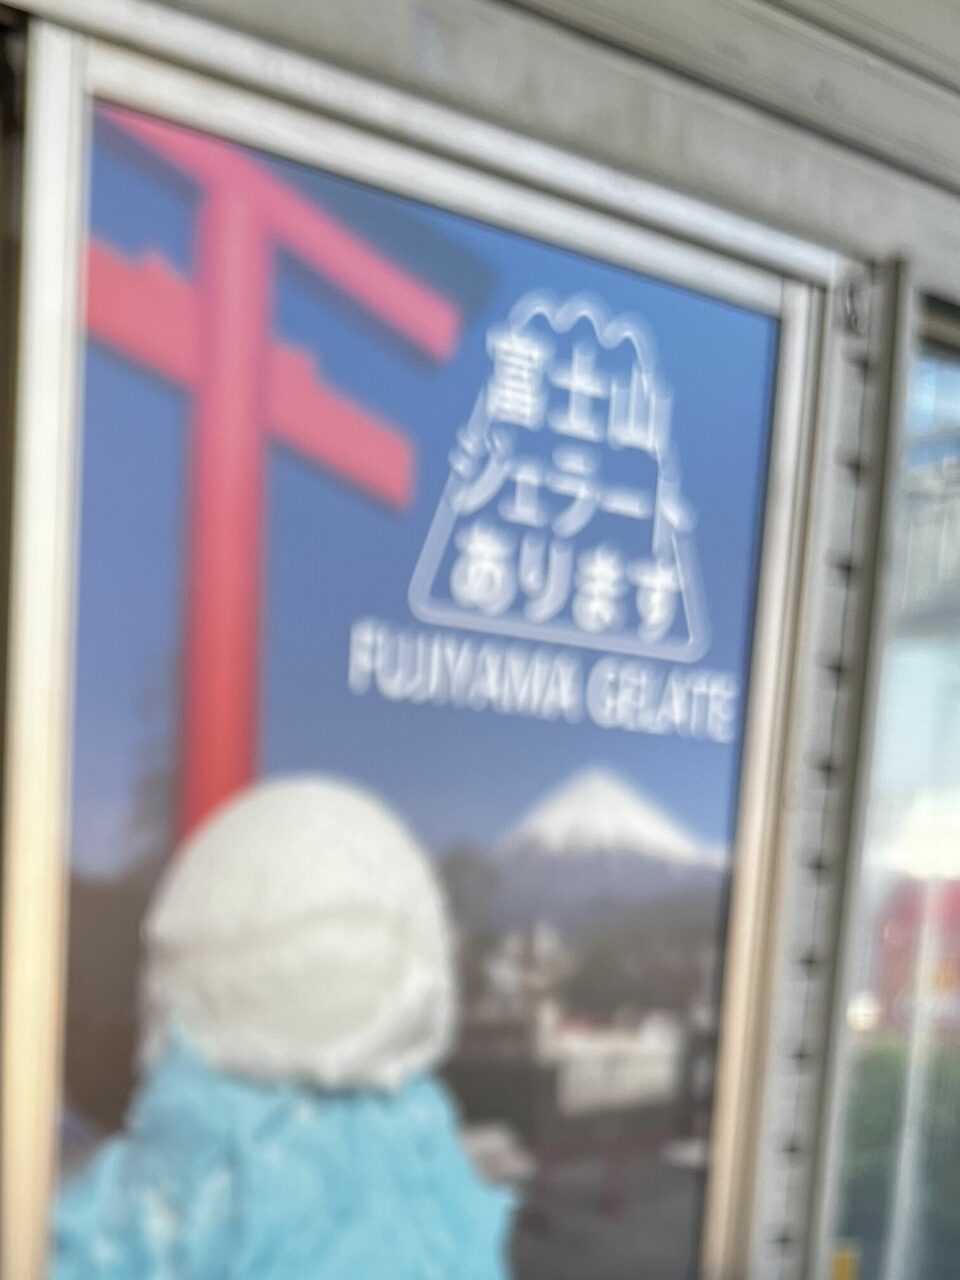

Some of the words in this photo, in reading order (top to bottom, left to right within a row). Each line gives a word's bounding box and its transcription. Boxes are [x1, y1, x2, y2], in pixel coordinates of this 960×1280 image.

[487, 326, 672, 456] 富士山
[448, 427, 694, 556] ジェラート
[451, 526, 684, 645] あります
[348, 620, 582, 722] FUJIYAMA
